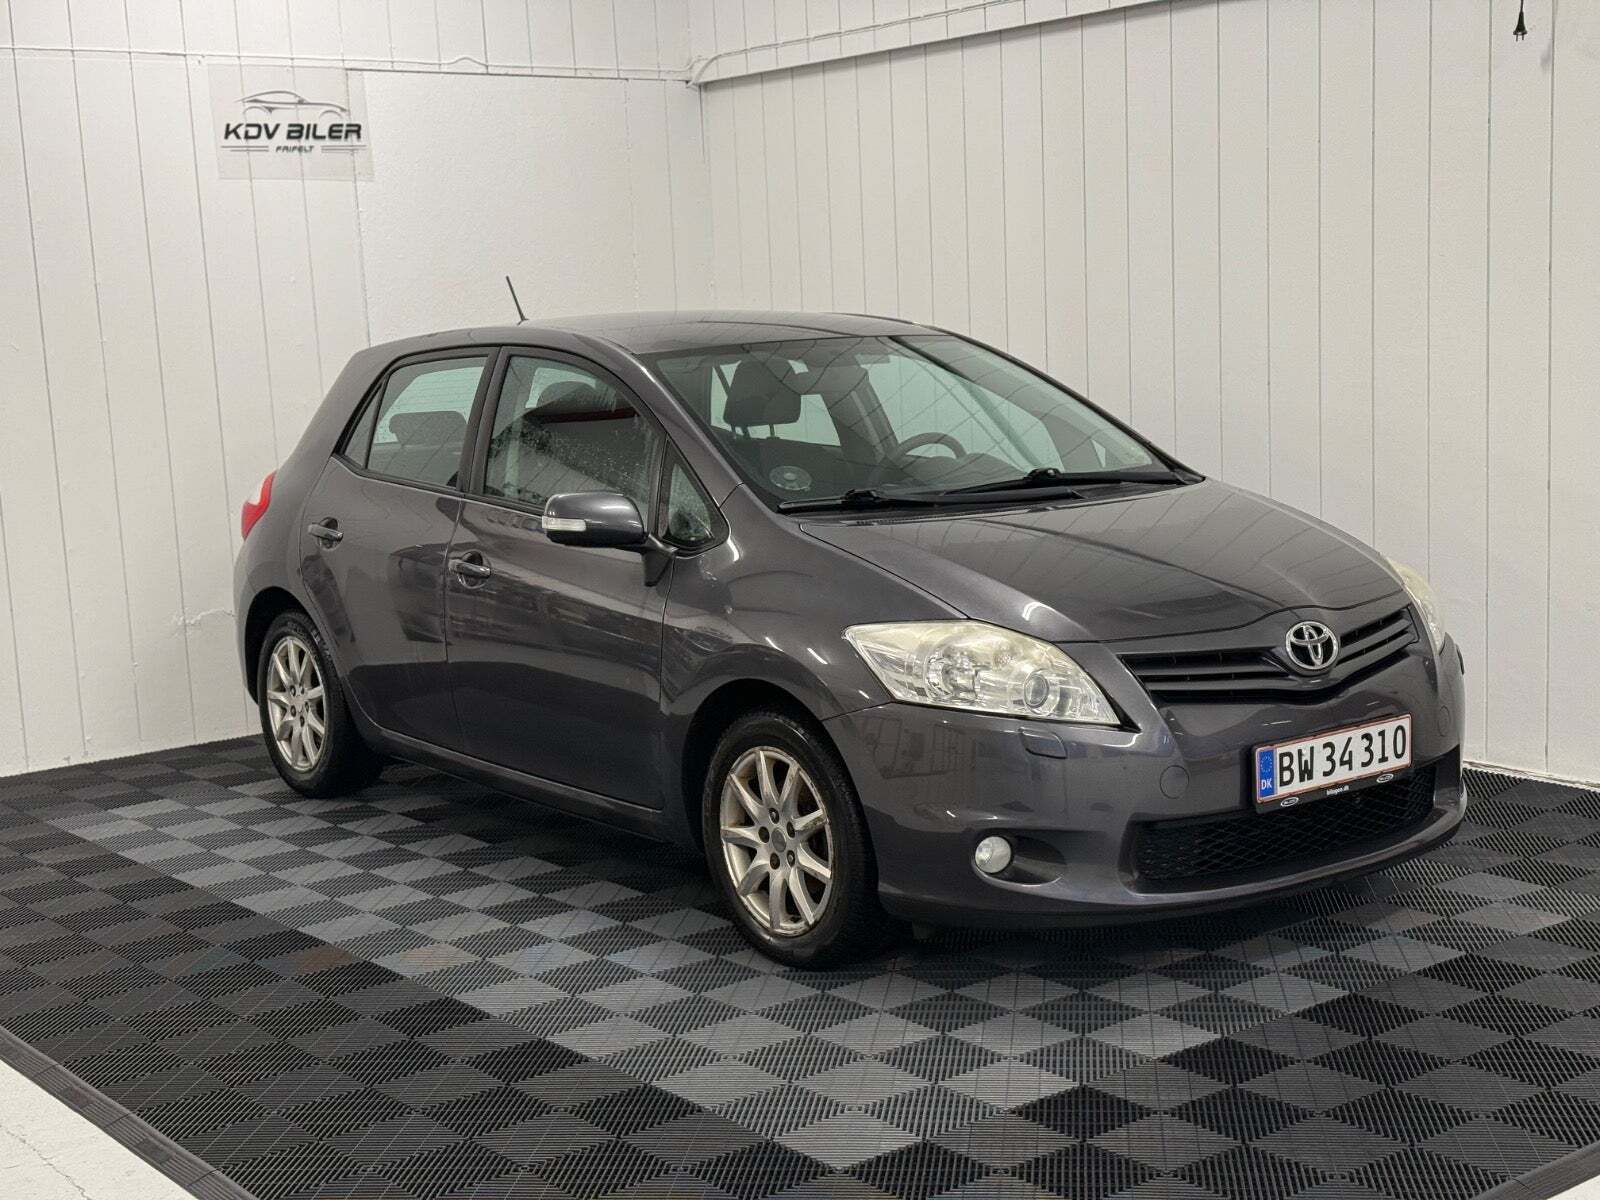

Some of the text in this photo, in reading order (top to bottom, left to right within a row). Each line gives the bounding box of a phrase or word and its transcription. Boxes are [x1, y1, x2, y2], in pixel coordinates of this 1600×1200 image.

[224, 123, 362, 141] KDV BILER
[275, 145, 315, 153] FRIFELT
[1279, 725, 1407, 787] BW 34 310
[1261, 778, 1273, 790] DK
